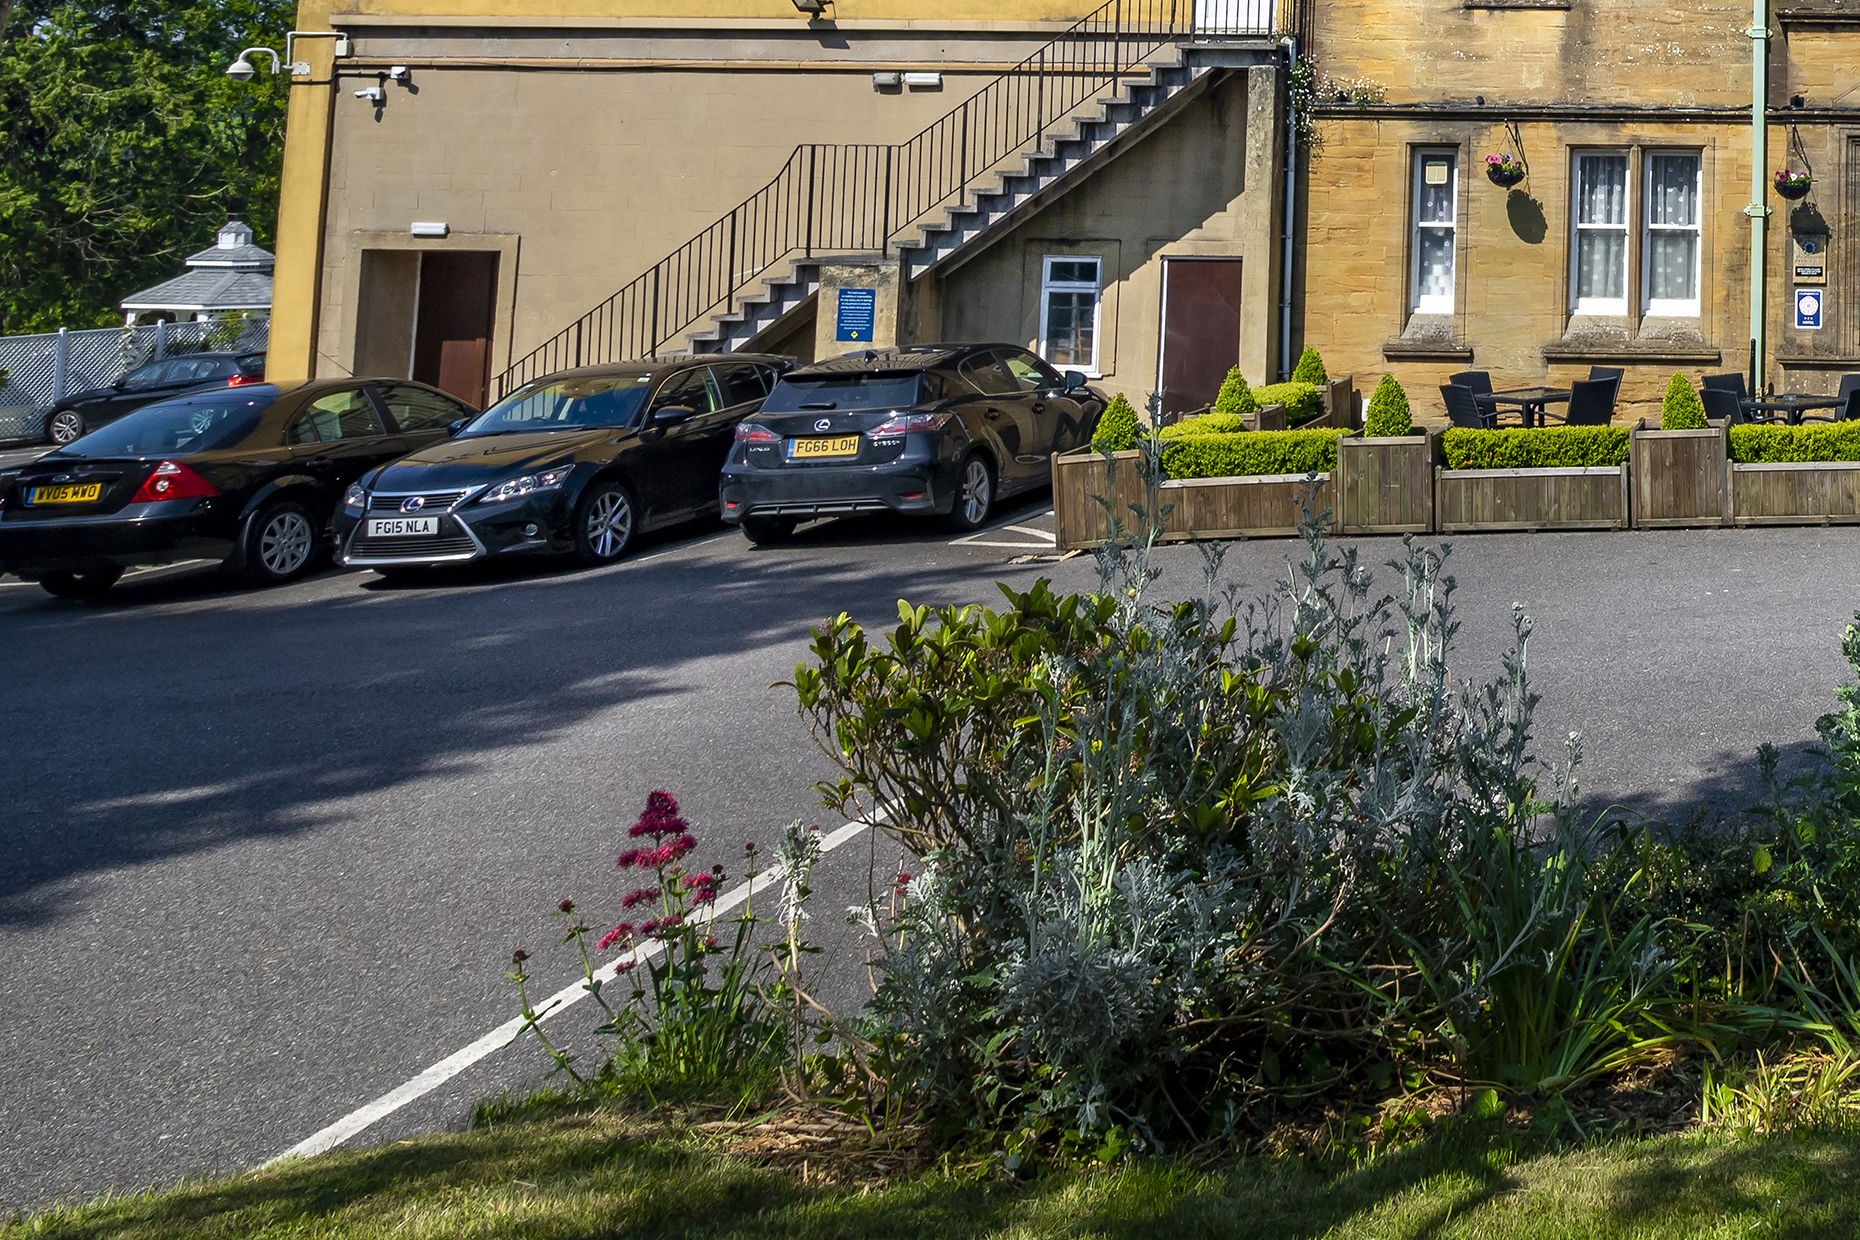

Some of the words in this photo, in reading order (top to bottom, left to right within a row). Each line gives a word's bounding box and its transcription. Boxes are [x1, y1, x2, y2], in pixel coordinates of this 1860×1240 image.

[796, 440, 829, 453] FG66
[831, 438, 857, 452] LOH
[375, 521, 403, 534] FG15
[405, 520, 430, 533] NLA
